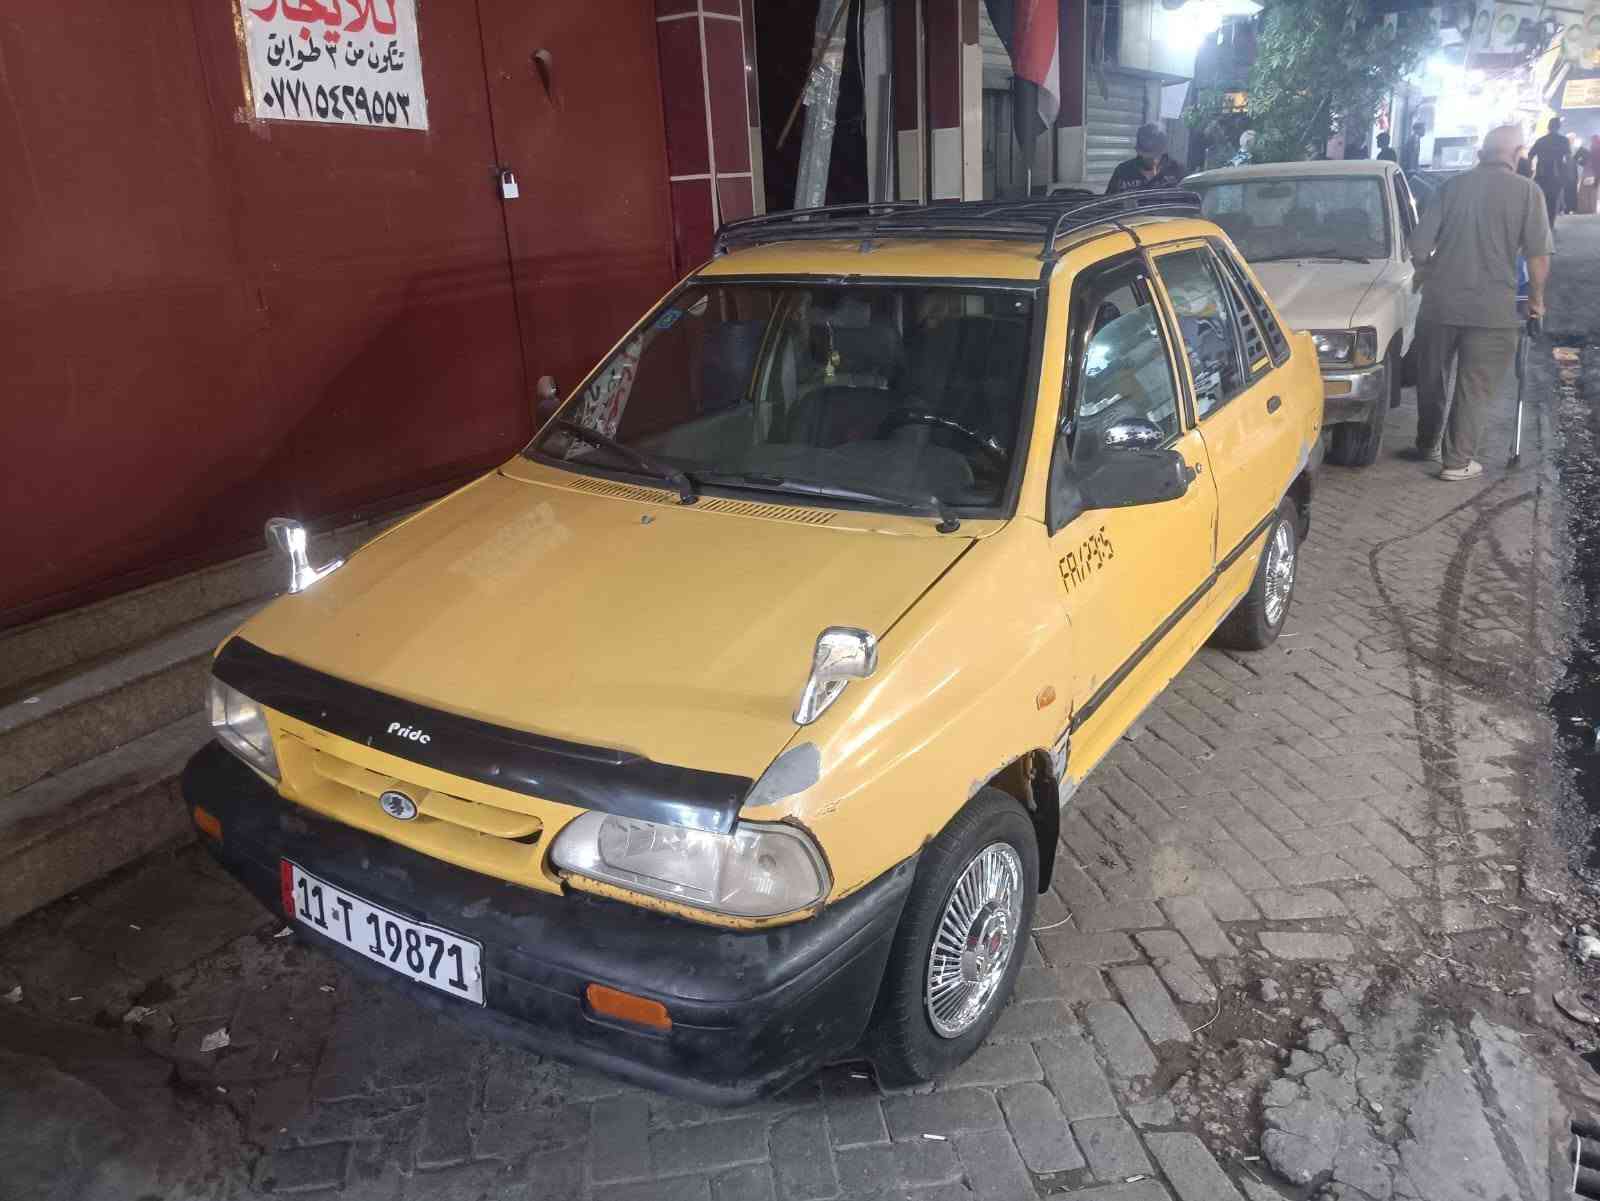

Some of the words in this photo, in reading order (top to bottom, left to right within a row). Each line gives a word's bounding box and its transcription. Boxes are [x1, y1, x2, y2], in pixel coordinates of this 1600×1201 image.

[267, 33, 321, 71] طوابق
[325, 44, 337, 70] ٣
[345, 41, 364, 66] من
[387, 722, 431, 744] Pride
[298, 878, 328, 930] 11
[337, 896, 353, 942] T
[366, 912, 468, 992] 19871
